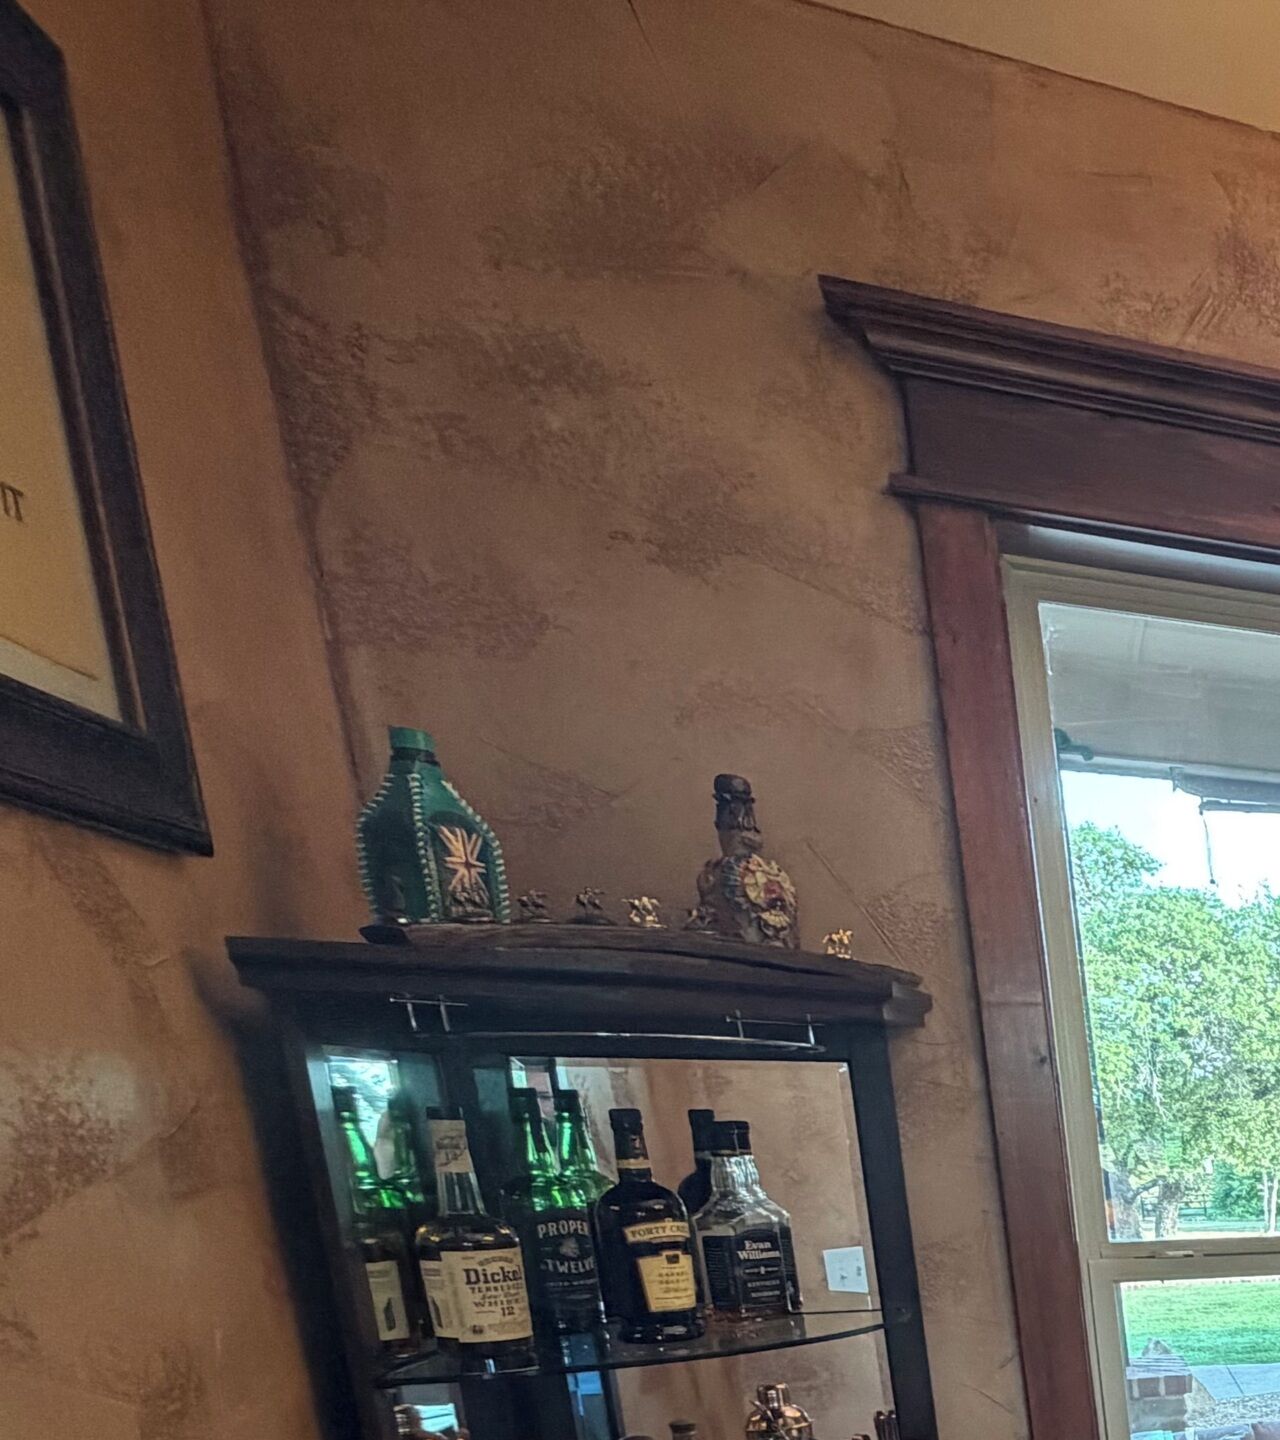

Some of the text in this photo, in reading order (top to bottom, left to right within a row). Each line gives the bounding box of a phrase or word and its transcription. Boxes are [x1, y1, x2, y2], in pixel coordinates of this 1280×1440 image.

[630, 1226, 666, 1238] FORTY
[744, 1240, 772, 1250] Evan
[737, 1251, 780, 1260] Williams
[463, 1265, 523, 1285] Dickel
[501, 1306, 515, 1317] 12
